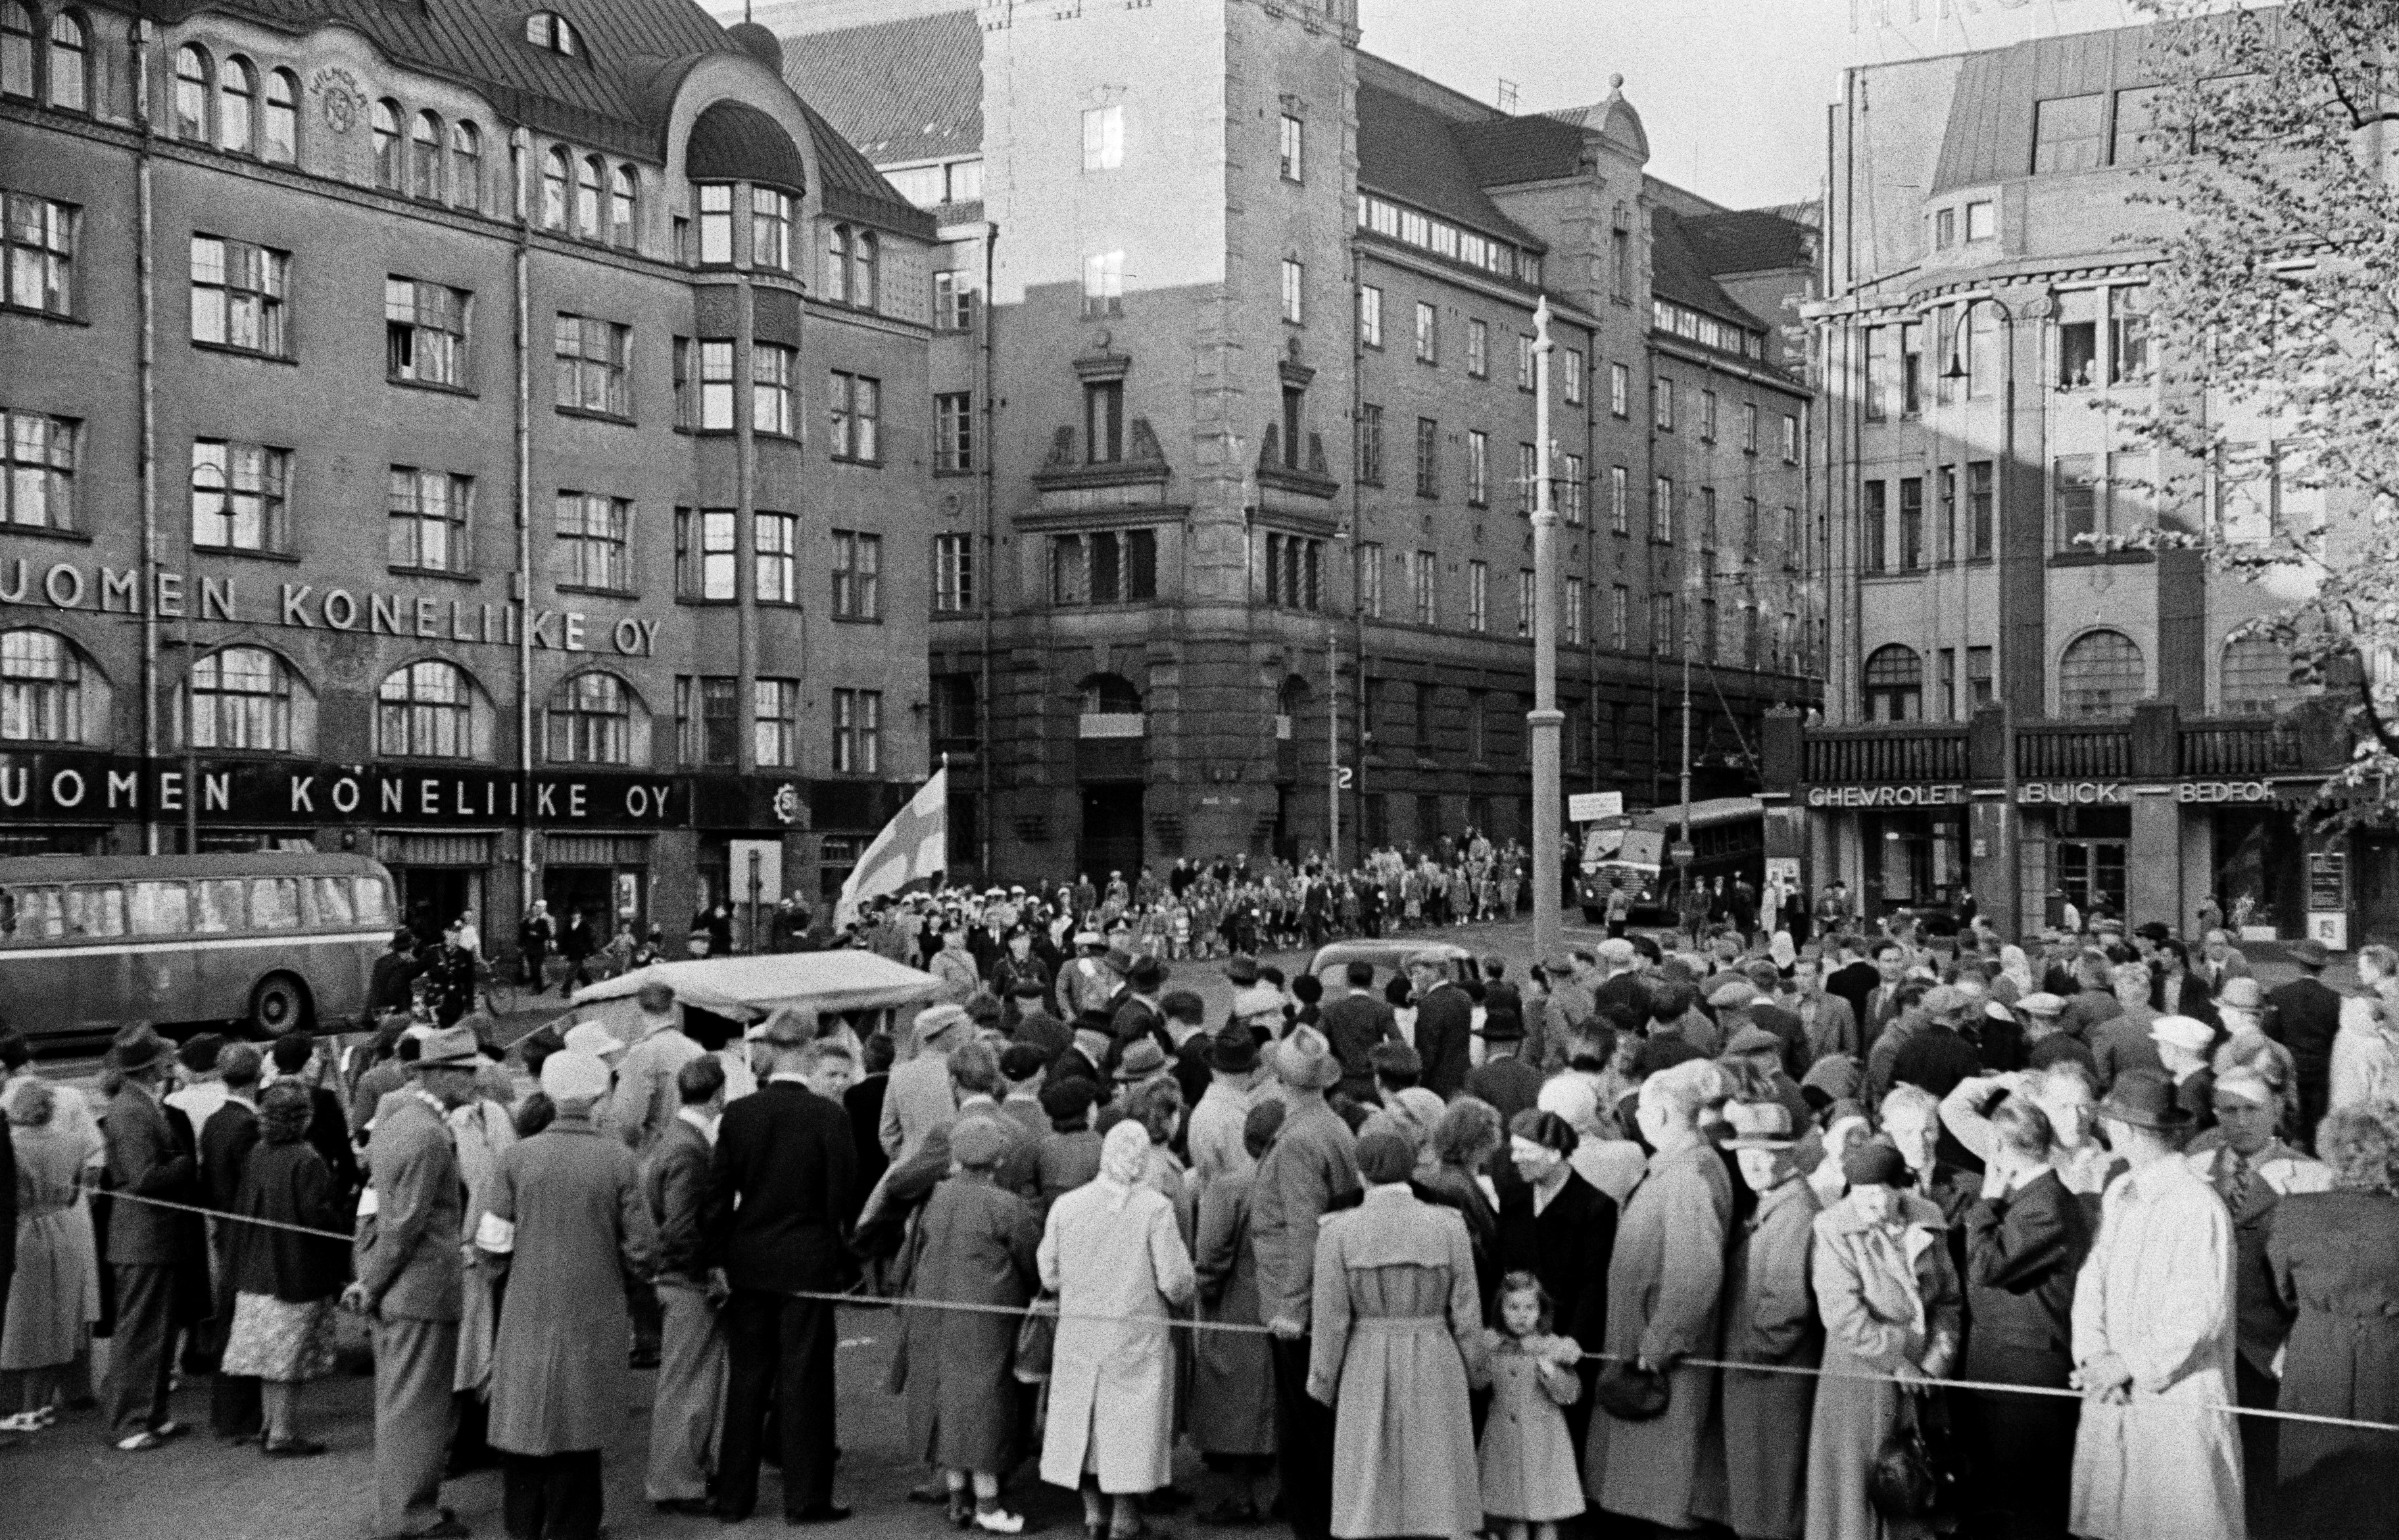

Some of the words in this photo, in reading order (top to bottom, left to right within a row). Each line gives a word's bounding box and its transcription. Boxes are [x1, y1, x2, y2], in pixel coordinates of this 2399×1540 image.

[0, 560, 237, 620] UOMEN
[283, 585, 585, 650] KONELIIKE
[616, 618, 662, 656] OY
[0, 767, 230, 810] UOMEN
[290, 775, 587, 817] KONELIIKE
[625, 786, 670, 817] OY
[1808, 785, 1962, 806] CHEVROLET
[2026, 782, 2118, 805] BUICK
